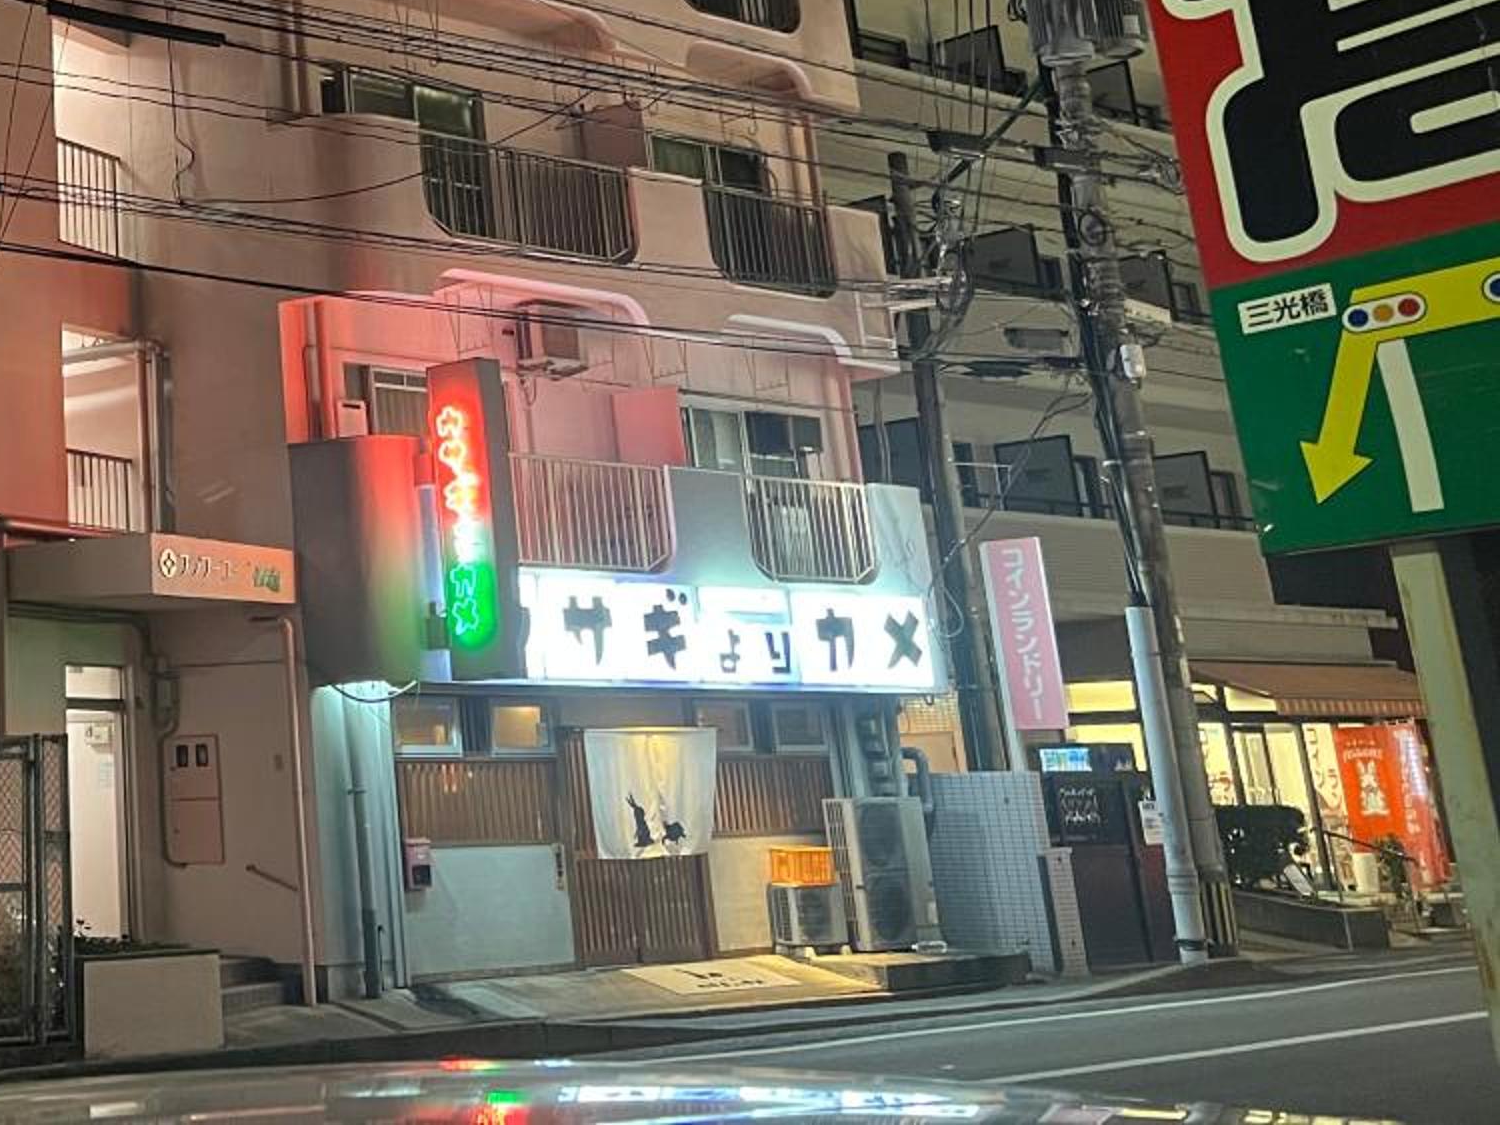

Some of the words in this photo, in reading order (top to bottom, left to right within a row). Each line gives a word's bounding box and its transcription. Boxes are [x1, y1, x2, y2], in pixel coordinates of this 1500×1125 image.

[1245, 288, 1329, 327] 三光橋
[519, 588, 923, 678] サギよりカメ
[1001, 548, 1044, 721] コインランドリー
